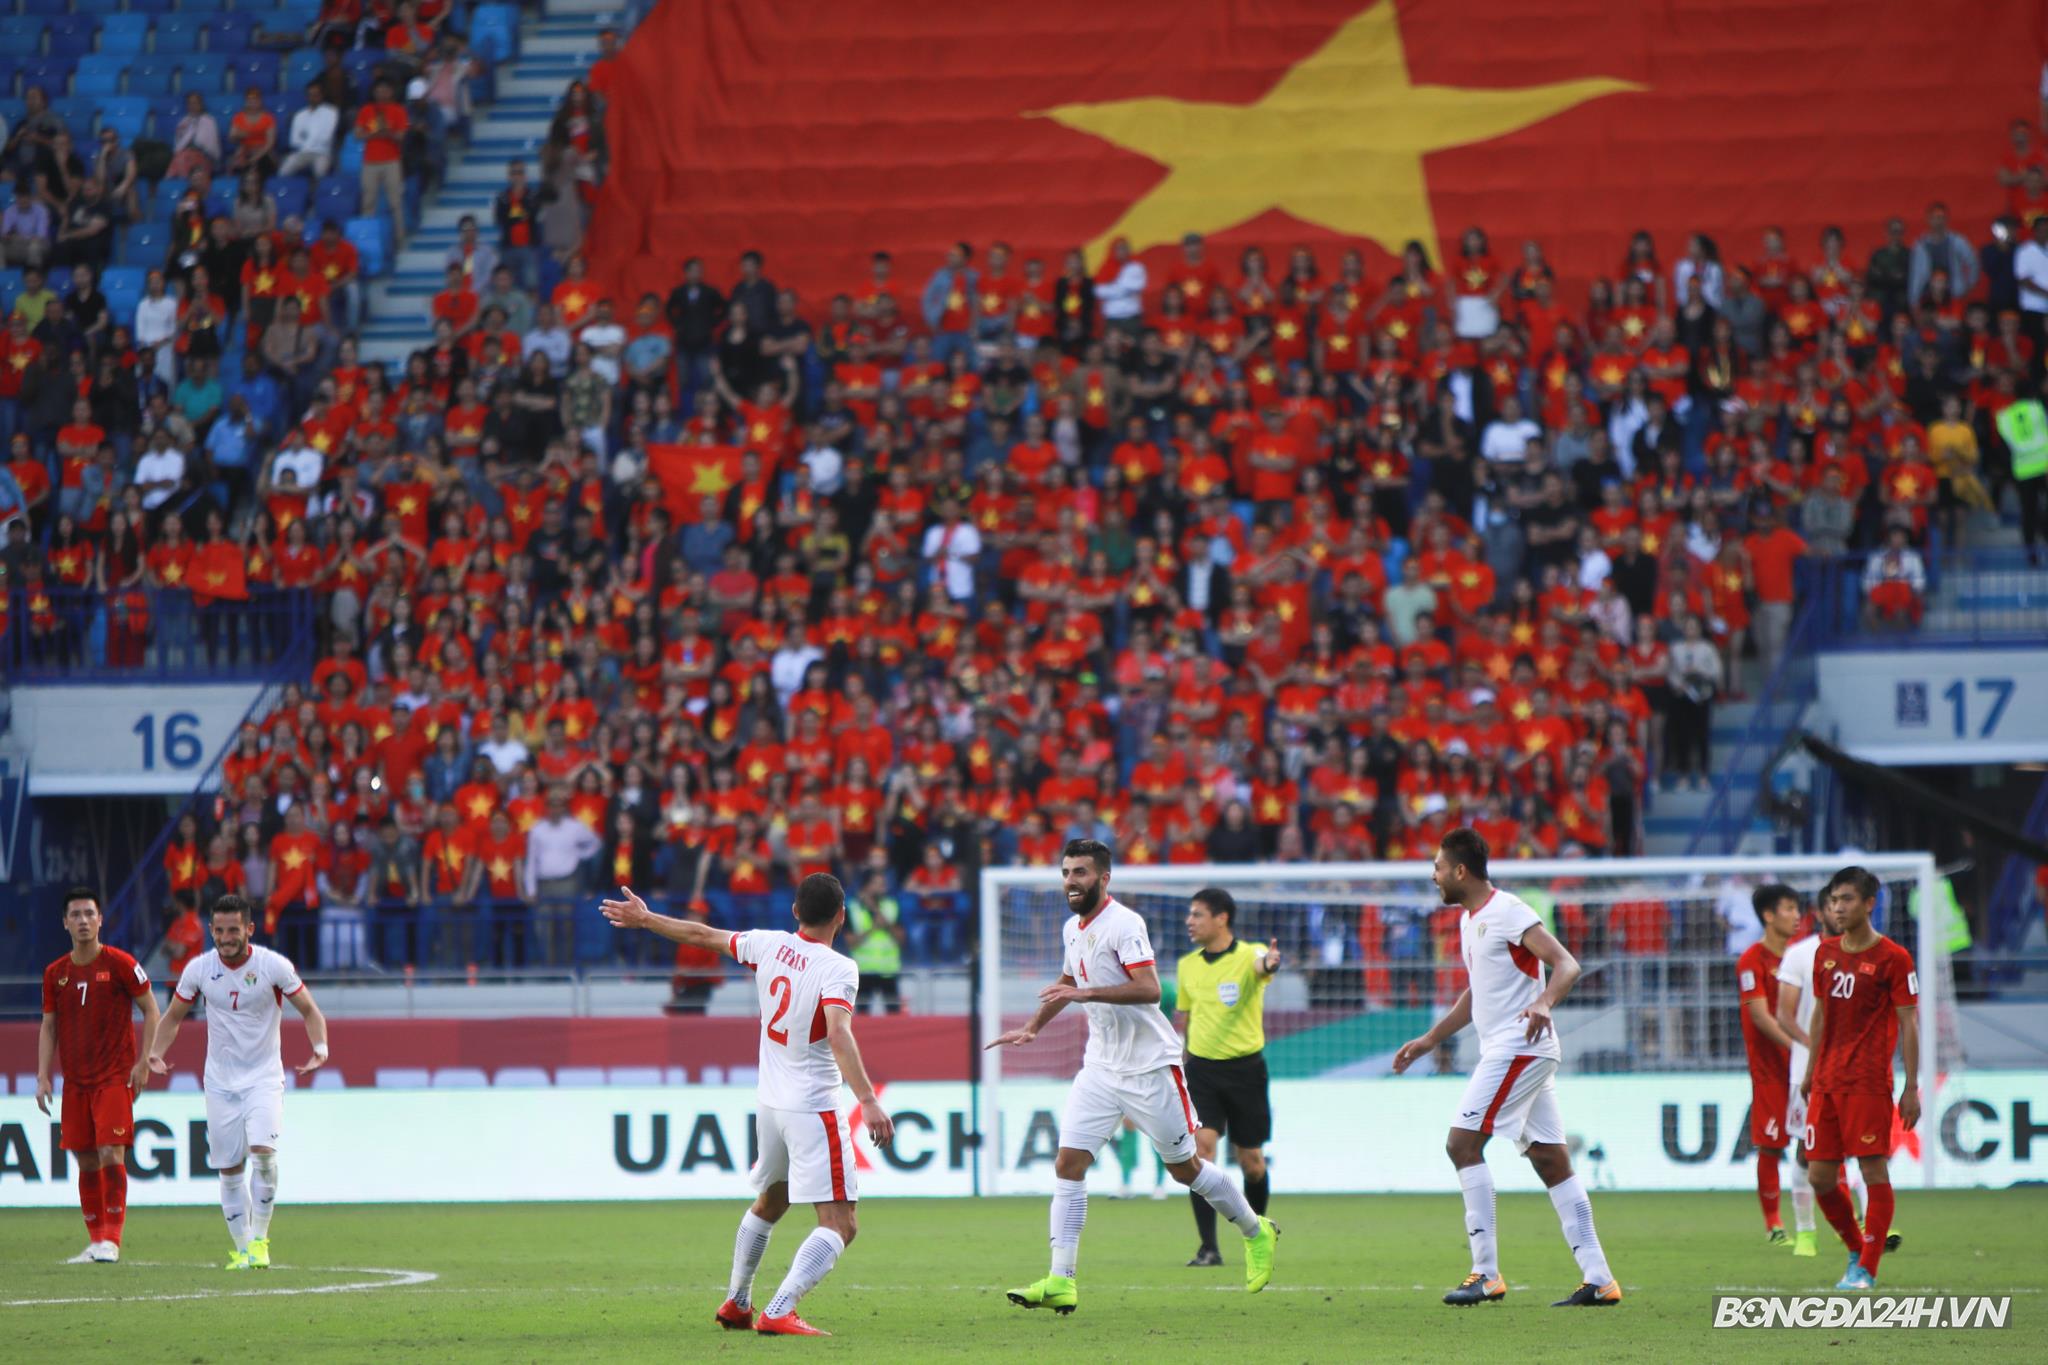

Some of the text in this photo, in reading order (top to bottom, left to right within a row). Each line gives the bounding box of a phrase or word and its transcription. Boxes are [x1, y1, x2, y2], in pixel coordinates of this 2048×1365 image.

[1943, 678, 2016, 738] 17
[132, 711, 203, 771] 16
[1078, 958, 1089, 982] 4
[76, 981, 88, 1006] 7
[1831, 971, 1855, 999] 20
[229, 991, 240, 1012] 7
[767, 975, 792, 1048] 2
[1764, 1116, 1779, 1142] 4
